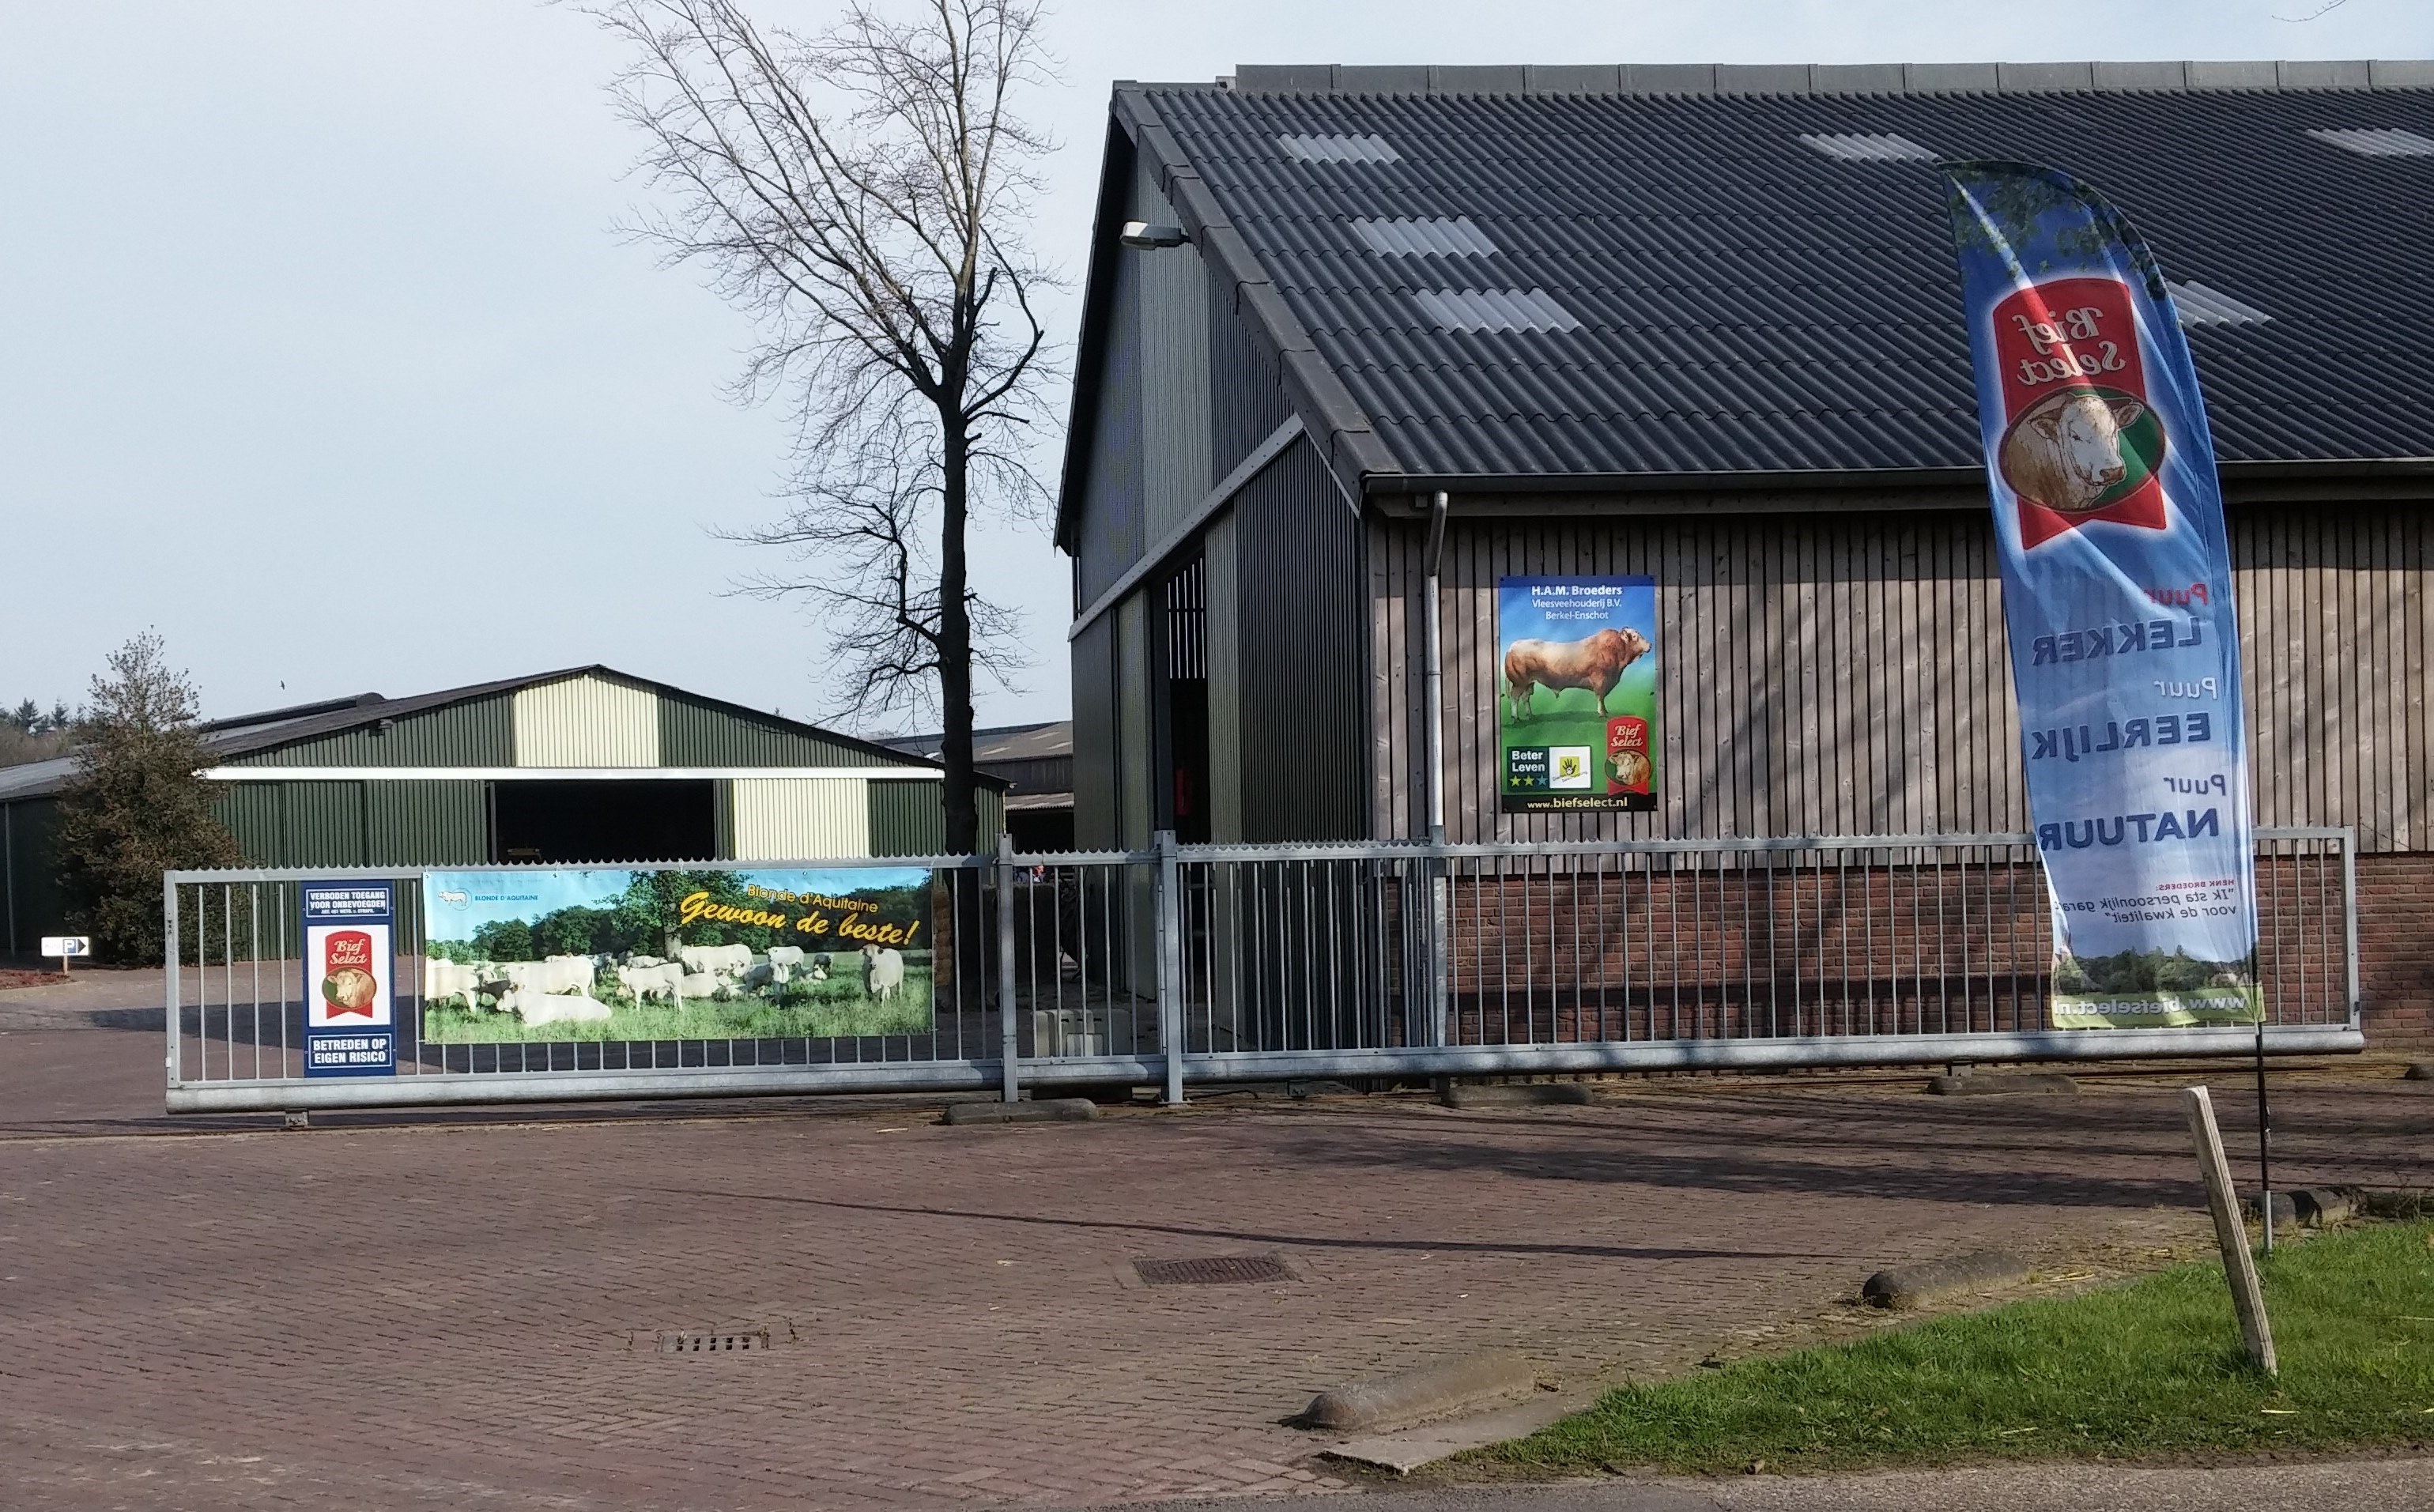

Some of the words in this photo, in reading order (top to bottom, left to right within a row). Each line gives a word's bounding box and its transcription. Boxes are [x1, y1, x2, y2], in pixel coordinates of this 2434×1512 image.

[1531, 586, 1569, 596] H.A.M.
[1572, 585, 1623, 596] Broeders
[1532, 599, 1606, 609] Vleesveehouderij
[1607, 598, 1622, 608] B.V.
[1545, 610, 1609, 621] Berkel-Enschot
[1614, 723, 1642, 741] Bief
[1611, 737, 1643, 747] Select
[1511, 751, 1543, 761] Beter
[1511, 762, 1545, 773] Leven
[1526, 796, 1628, 809] www.biefselect.nl
[310, 892, 349, 900] VERBODEN
[351, 891, 385, 899] TOEGANG
[748, 884, 796, 903] Blonde
[799, 892, 879, 914] d'Aquitaine
[310, 900, 330, 909] VOOR
[332, 899, 386, 908] ONBEVOEGDEN
[680, 891, 787, 929] Gewoon
[796, 910, 829, 935] de
[838, 912, 920, 945] beste!
[65, 939, 75, 953] P
[334, 938, 366, 955] Bief
[330, 952, 368, 965] Select
[313, 1039, 369, 1050] BETREDEN
[372, 1038, 387, 1050] OP
[314, 1052, 346, 1064] EIGEN
[349, 1050, 386, 1063] RISICO
